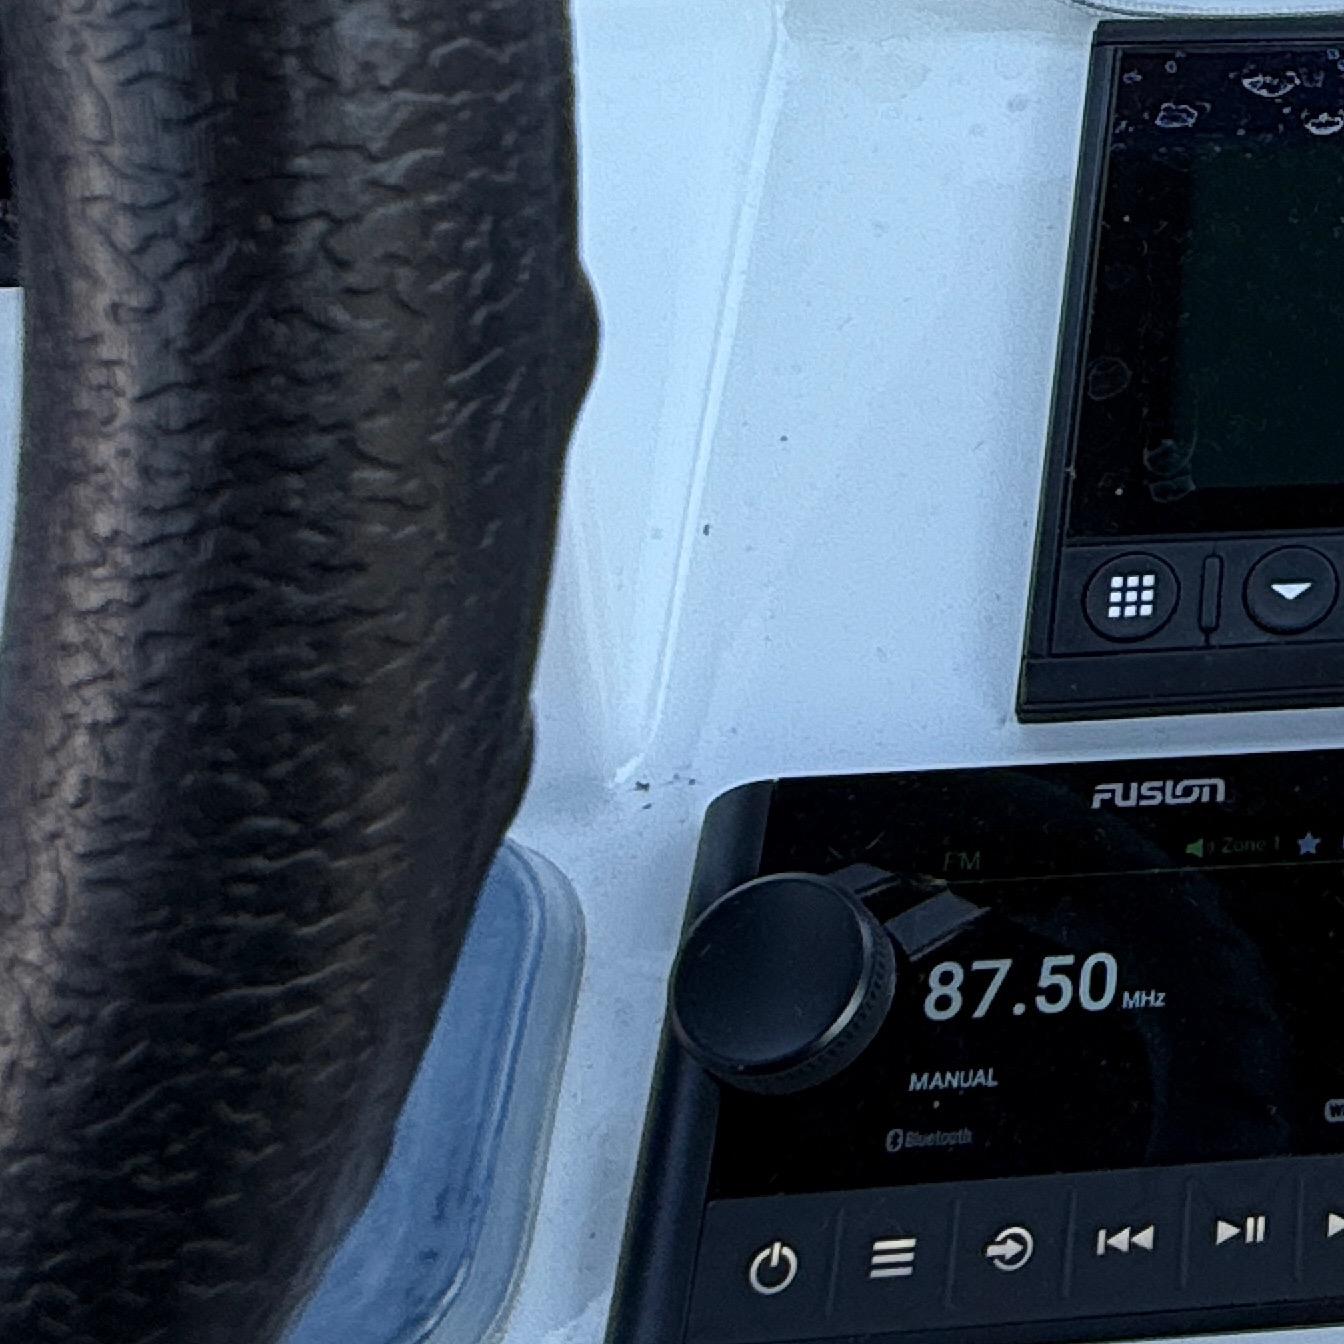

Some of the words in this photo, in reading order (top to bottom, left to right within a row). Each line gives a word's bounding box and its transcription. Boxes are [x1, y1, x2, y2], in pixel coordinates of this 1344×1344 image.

[1091, 778, 1226, 809] FUSION
[923, 952, 1118, 1021] 87.50
[1122, 990, 1166, 1009] MHz
[908, 1068, 998, 1092] MANUAL
